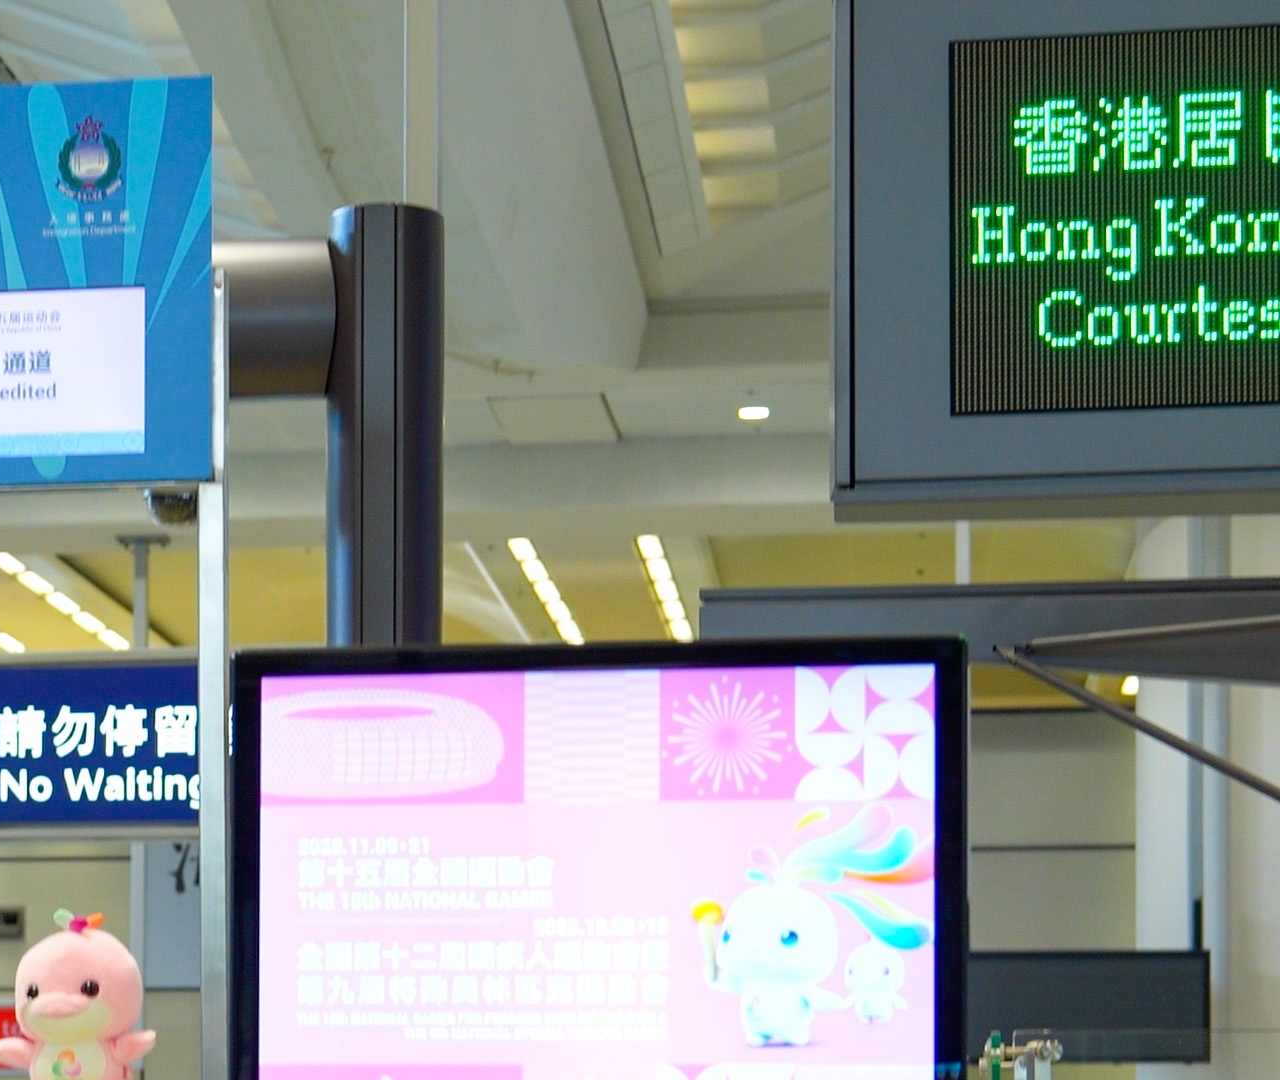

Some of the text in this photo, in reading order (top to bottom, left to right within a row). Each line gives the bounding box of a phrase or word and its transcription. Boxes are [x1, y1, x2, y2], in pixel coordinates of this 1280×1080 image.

[1014, 89, 1280, 175] 香港居
[972, 206, 1137, 281] Hong
[0, 768, 54, 803] No
[384, 889, 481, 911] NATIONAL
[484, 888, 554, 910] GAMES
